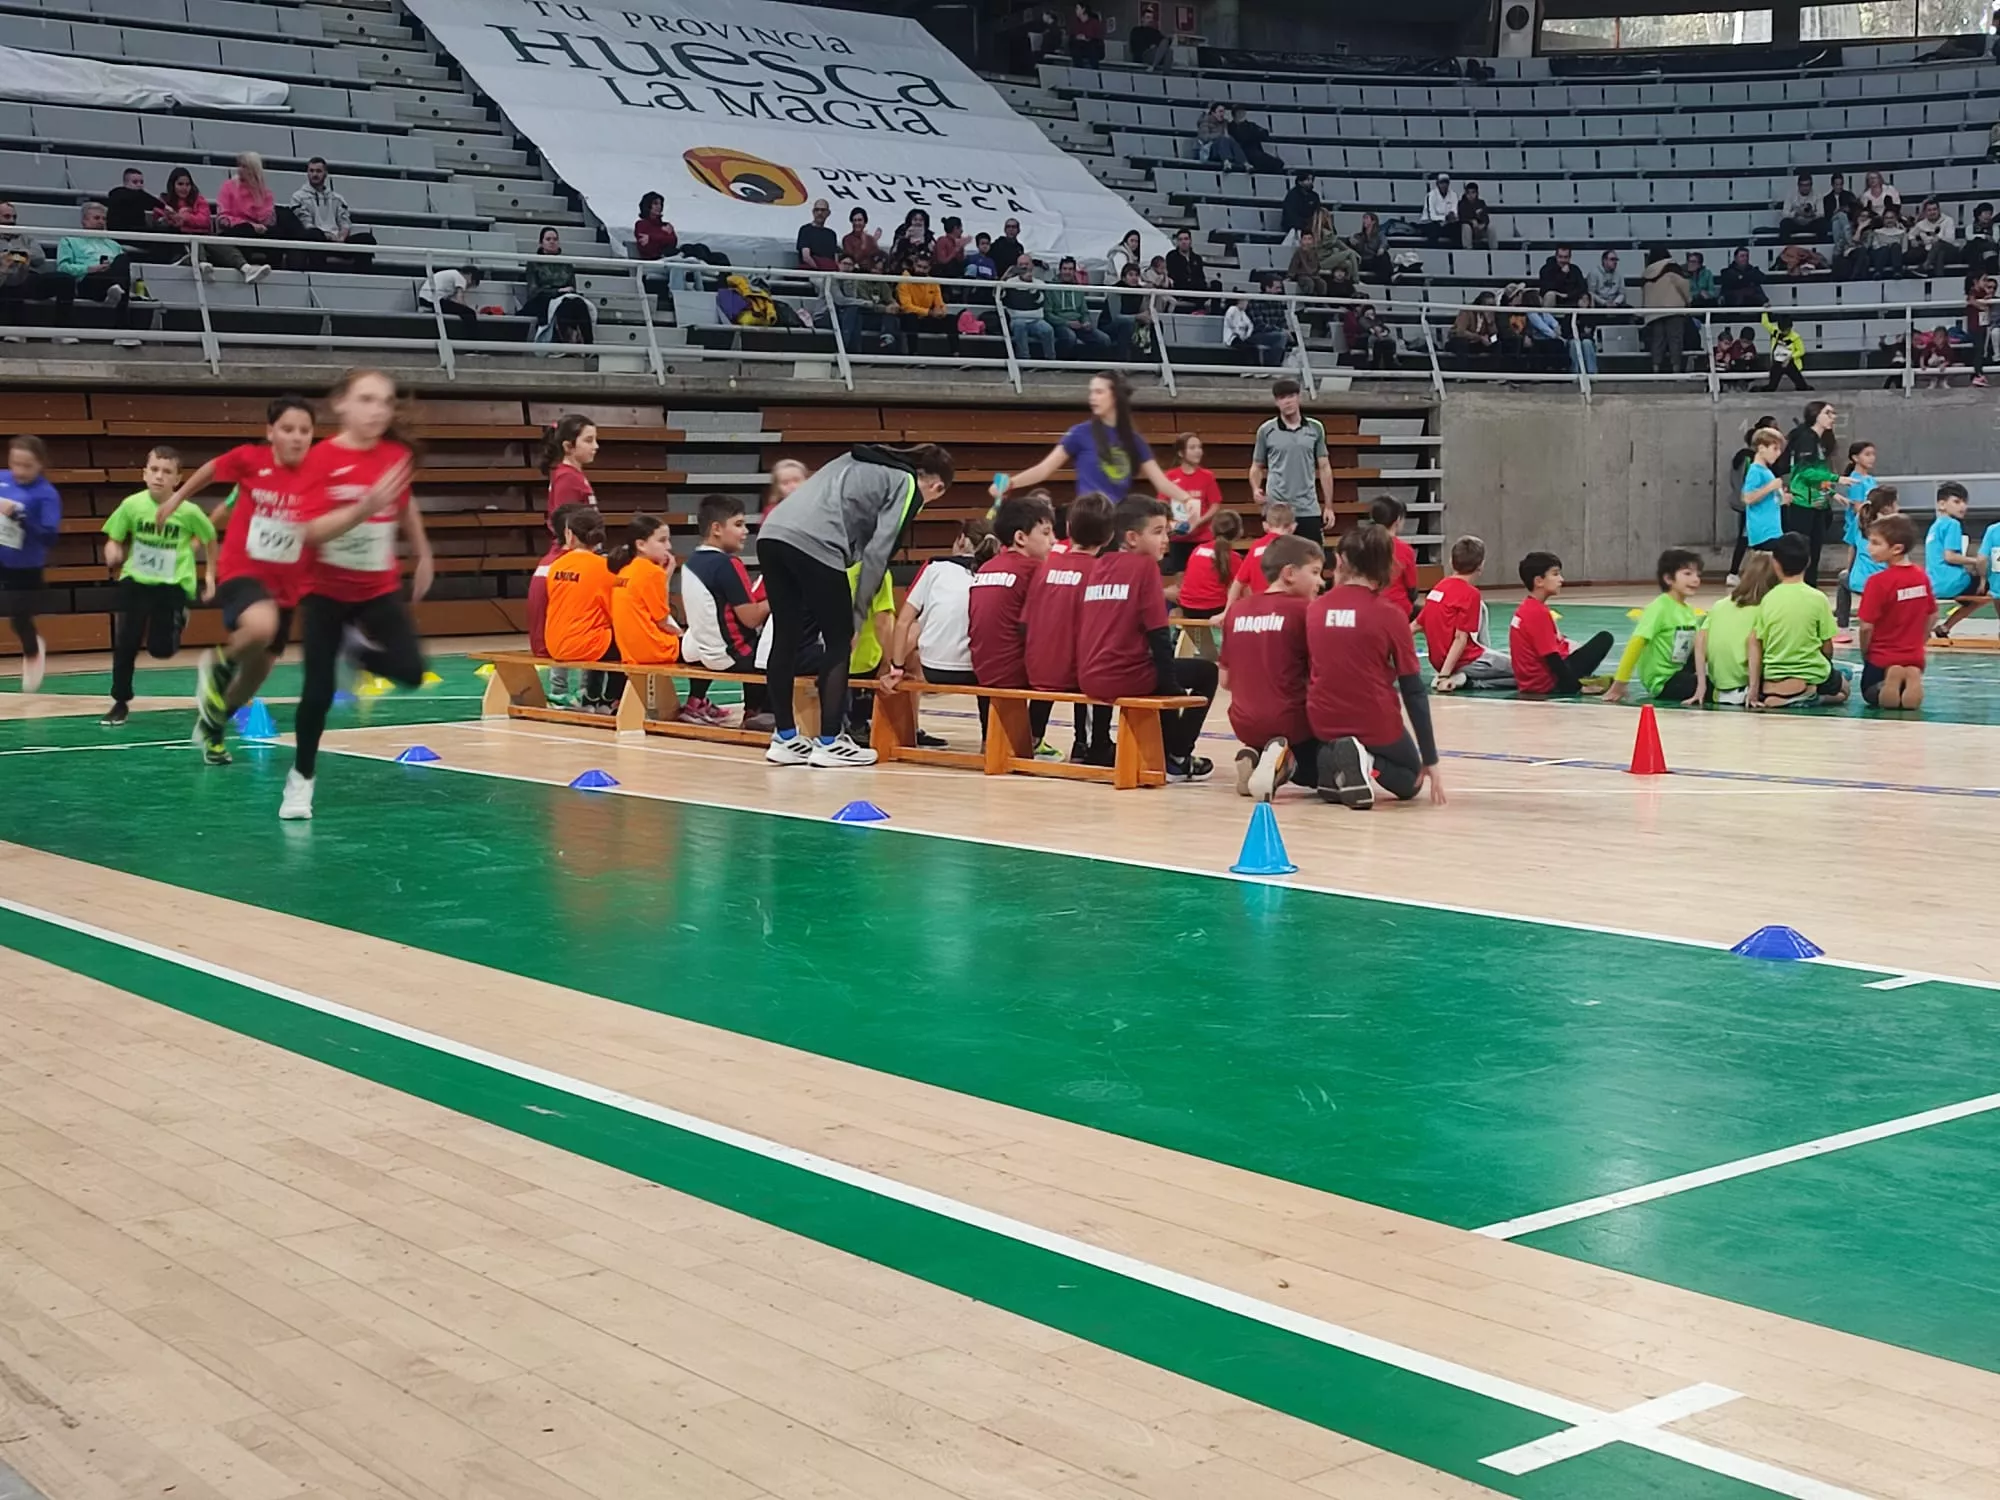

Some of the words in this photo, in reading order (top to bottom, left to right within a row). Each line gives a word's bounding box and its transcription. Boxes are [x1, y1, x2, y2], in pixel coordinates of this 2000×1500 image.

[484, 23, 968, 110] Huesca
[827, 184, 1033, 214] HUESCA
[1046, 569, 1082, 586] DIEGO
[1325, 609, 1356, 628] EVA
